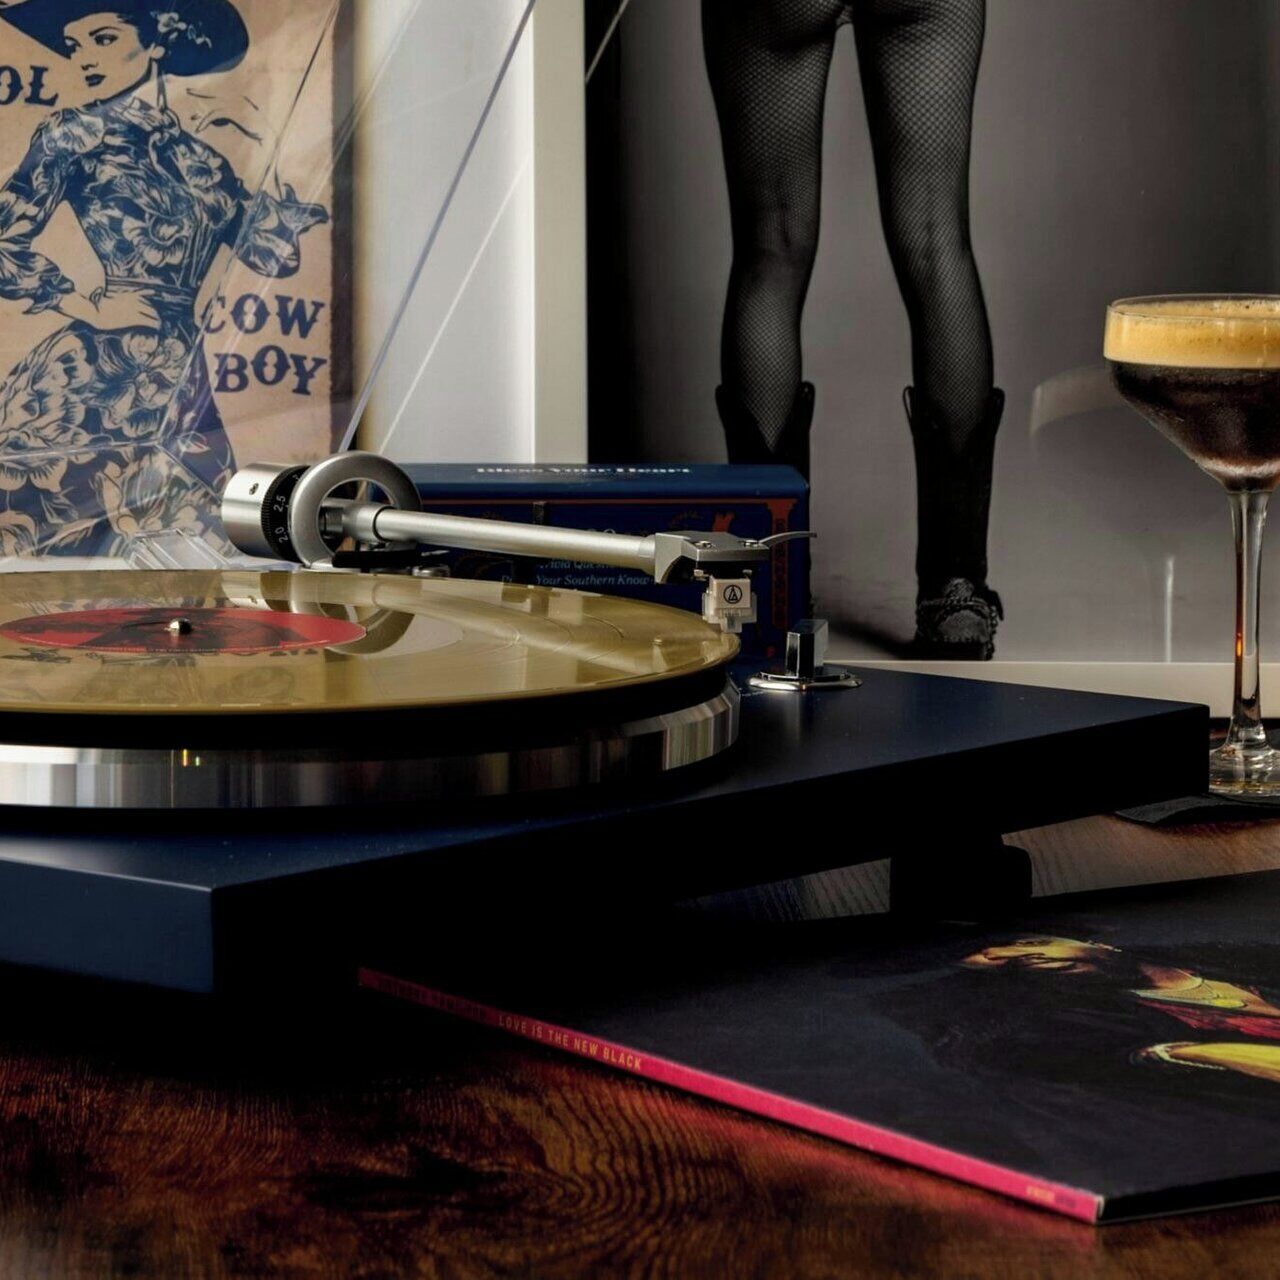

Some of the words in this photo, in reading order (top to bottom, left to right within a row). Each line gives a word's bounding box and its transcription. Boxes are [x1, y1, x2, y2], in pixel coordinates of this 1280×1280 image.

[200, 292, 325, 339] COW
[214, 345, 327, 395] BOY
[273, 495, 286, 512] 2.5
[274, 526, 289, 543] 2.0
[536, 575, 561, 586] Your
[564, 573, 616, 586] Southern
[499, 1015, 526, 1033] LOVE
[532, 1024, 542, 1039] IS
[548, 1030, 569, 1048] THE
[574, 1038, 598, 1056] NEW
[603, 1049, 641, 1071] BLACK
